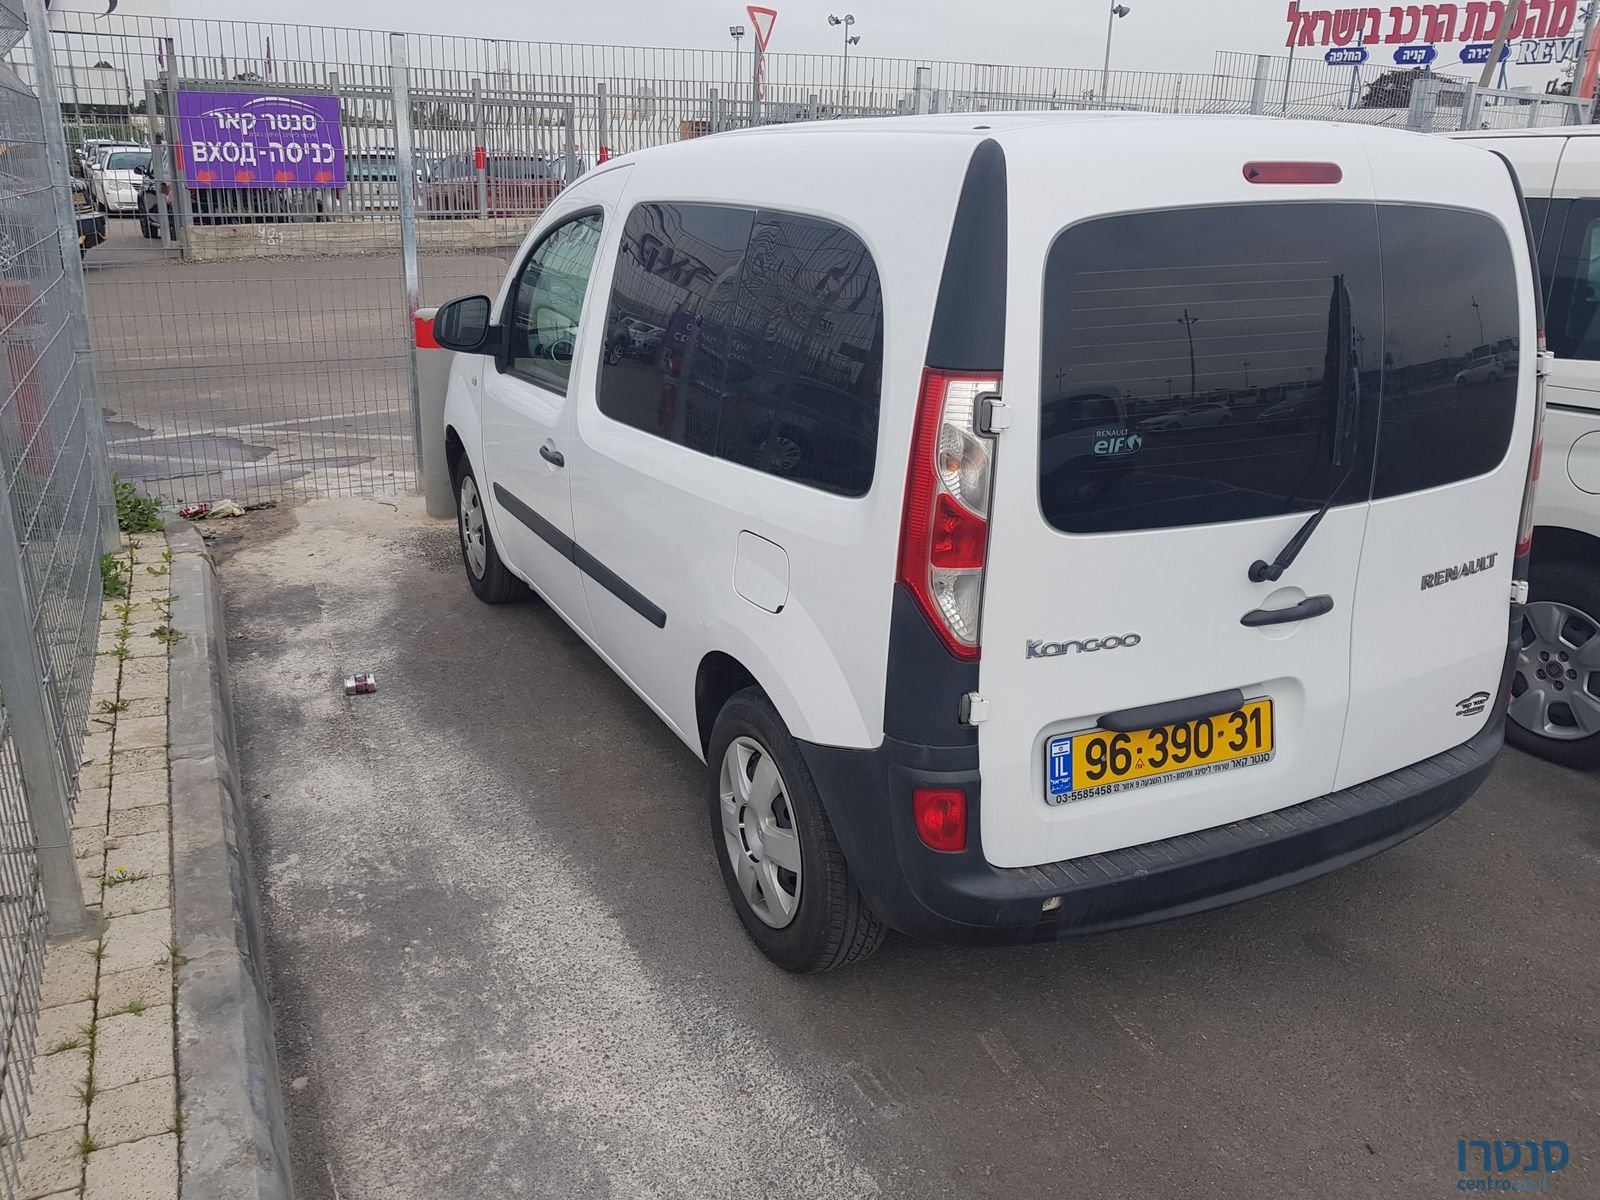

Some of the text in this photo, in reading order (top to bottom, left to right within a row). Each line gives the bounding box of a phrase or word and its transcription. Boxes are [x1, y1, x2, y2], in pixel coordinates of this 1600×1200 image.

[1285, 1, 1381, 47] בישראל
[1384, 4, 1457, 44] הרכב
[1329, 49, 1361, 62] החלפה
[1402, 49, 1426, 62] קניה
[209, 112, 316, 135] סנטר קאר
[1096, 429, 1128, 437] RENAULT
[1094, 437, 1126, 454] elf
[1420, 552, 1498, 591] RENAULT
[1025, 632, 1142, 659] Kangoo
[1055, 756, 1069, 777] IL
[1230, 757, 1248, 767] קאר
[1250, 753, 1270, 764] סנטר
[1135, 780, 1140, 788] 9
[1056, 785, 1112, 804] 03-5585458
